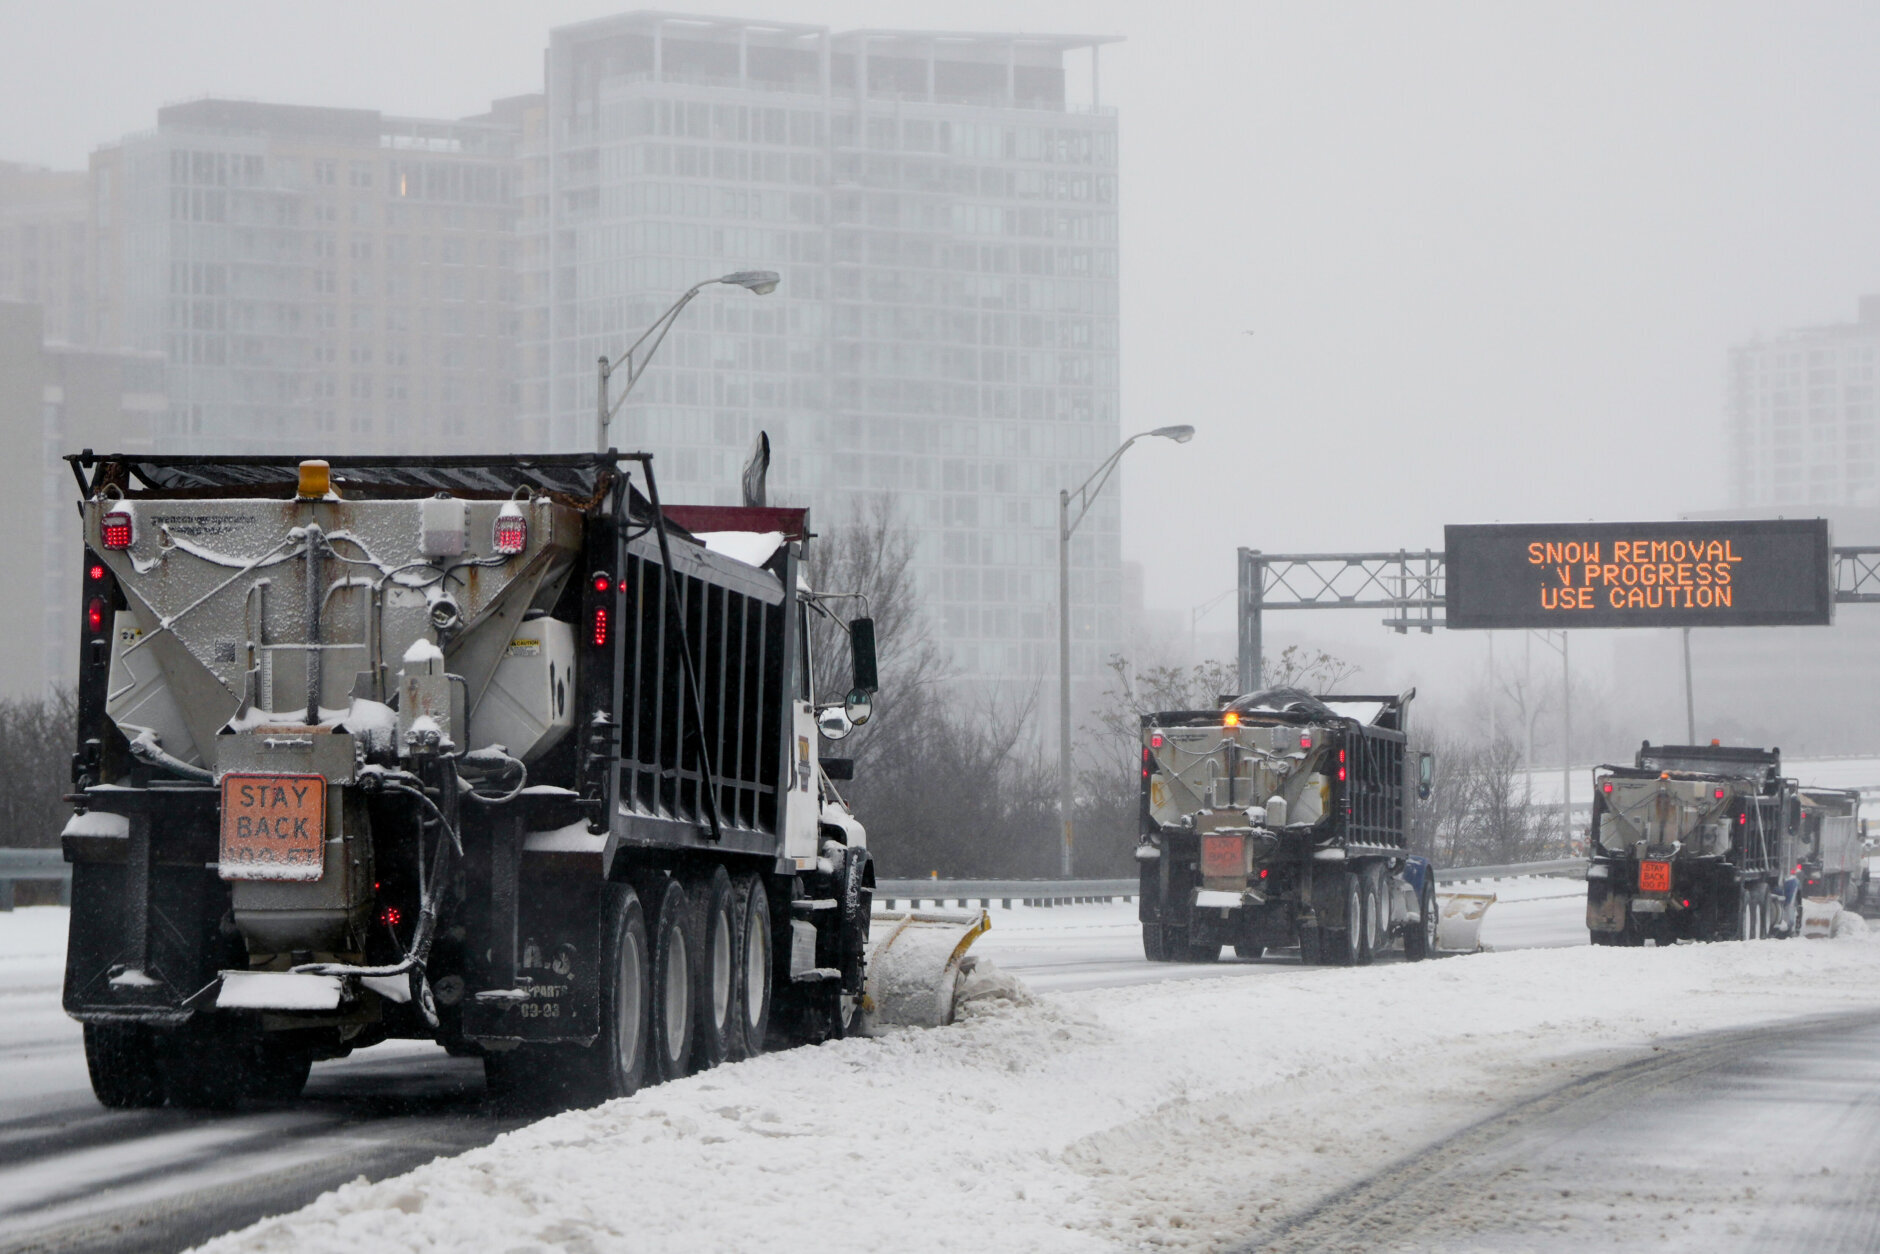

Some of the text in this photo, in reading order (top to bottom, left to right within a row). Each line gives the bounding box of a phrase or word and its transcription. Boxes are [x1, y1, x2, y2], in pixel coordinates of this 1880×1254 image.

[1528, 540, 1742, 564] SNOW REMOVAL
[1585, 563, 1731, 586] PROGRESS
[1541, 586, 1732, 609] USE CAUTION
[240, 784, 309, 808] STAY
[237, 815, 309, 840] BACK
[1643, 872, 1665, 880] BACK
[1645, 863, 1665, 871] STAY
